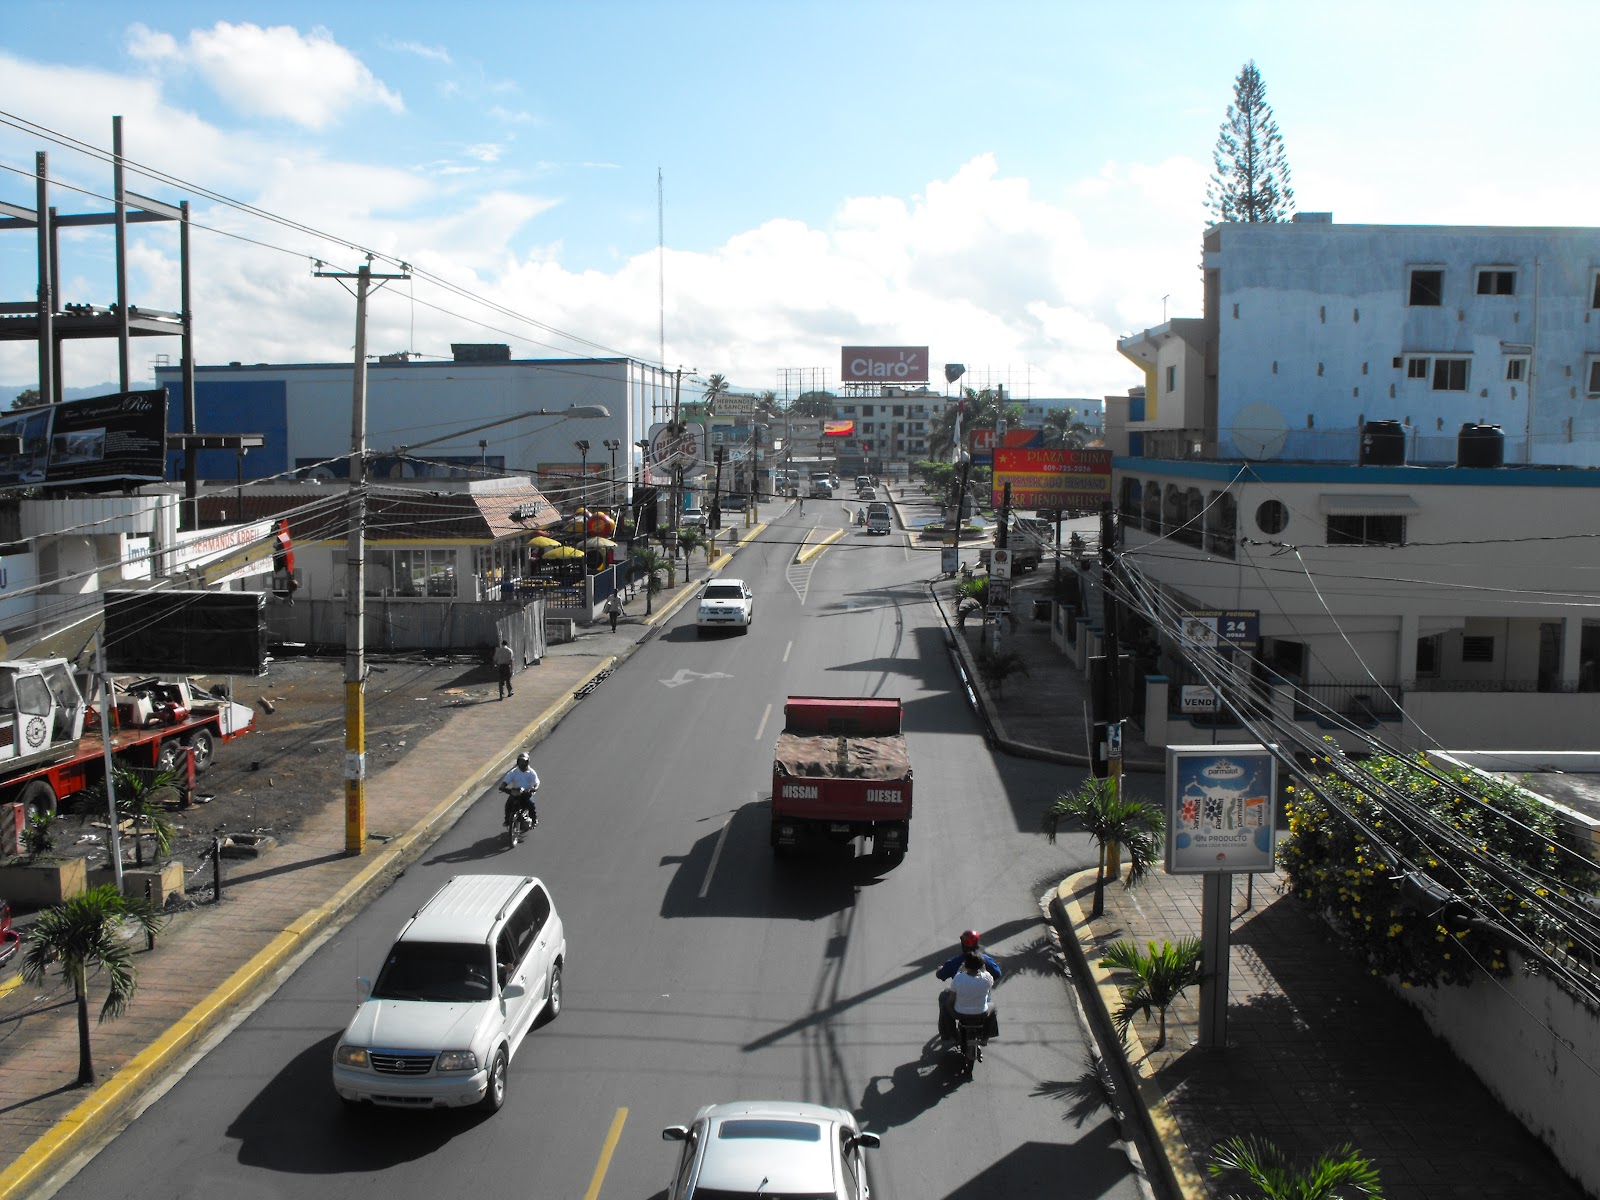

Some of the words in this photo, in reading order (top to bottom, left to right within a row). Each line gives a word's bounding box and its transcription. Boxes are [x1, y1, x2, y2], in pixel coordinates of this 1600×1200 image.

[851, 358, 909, 377] Claro
[1027, 450, 1065, 462] PLAZA
[1070, 451, 1107, 464] CHINA
[997, 493, 1026, 505] SPER
[1029, 493, 1064, 506] TIENDA
[1226, 621, 1246, 632] 24
[1208, 768, 1239, 776] parmalat
[782, 785, 818, 799] NISSAN
[867, 789, 903, 804] DIESEL
